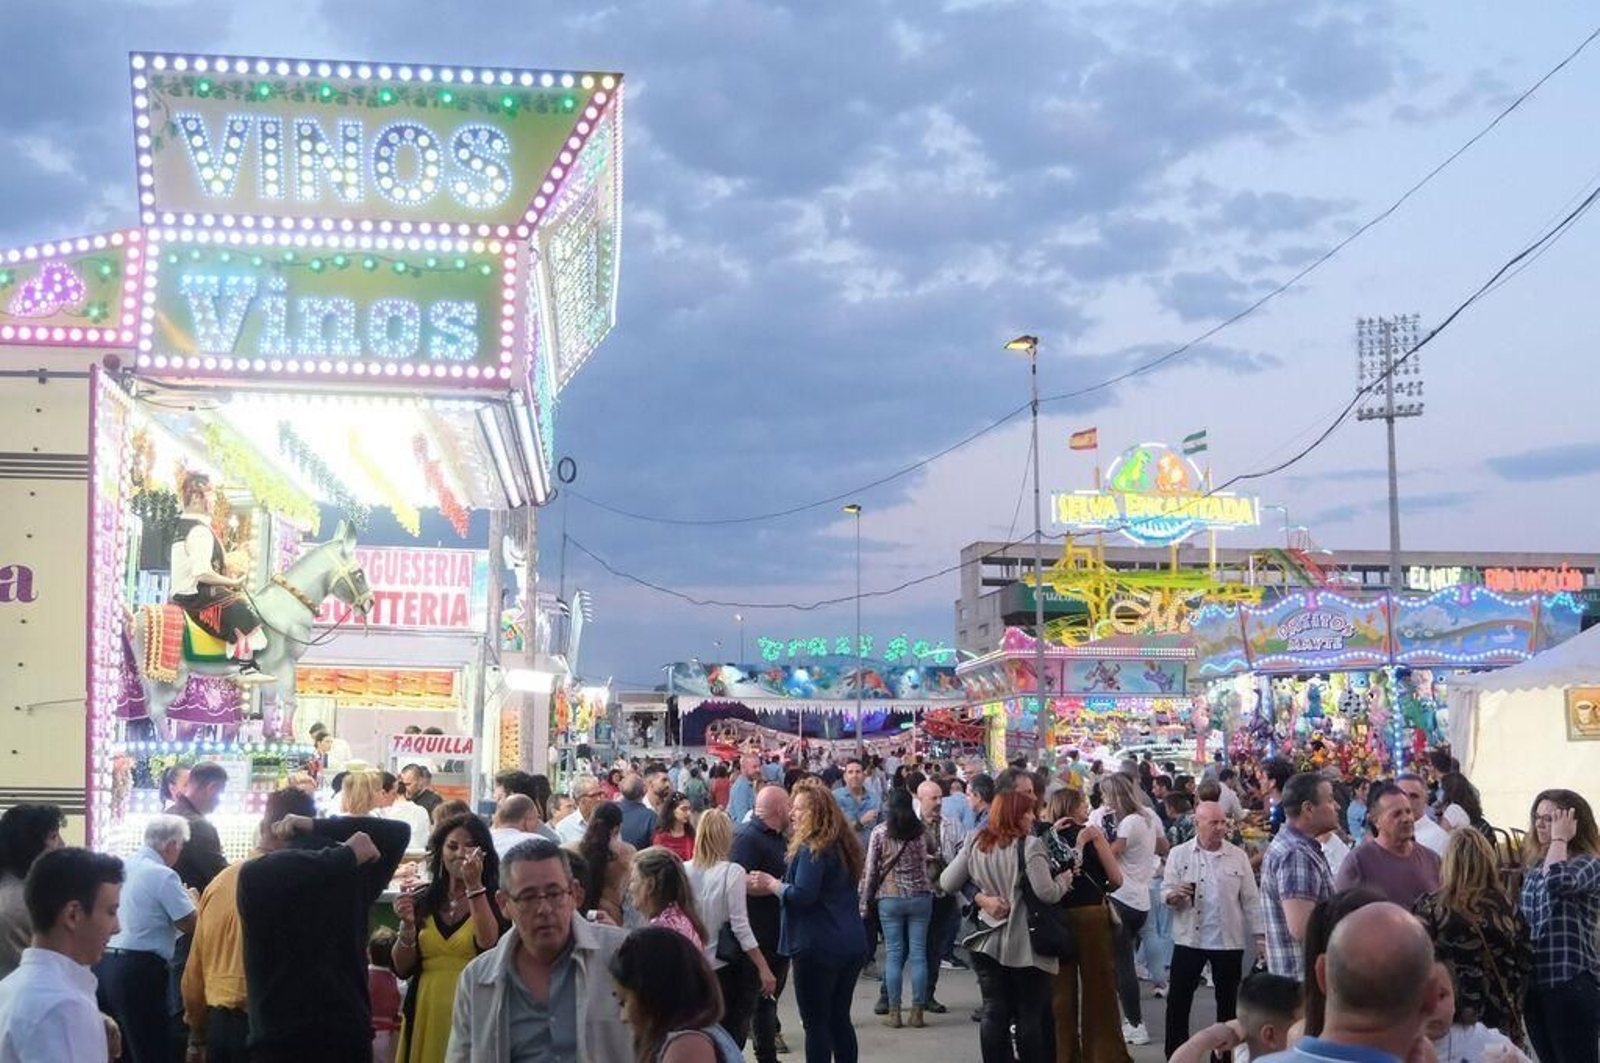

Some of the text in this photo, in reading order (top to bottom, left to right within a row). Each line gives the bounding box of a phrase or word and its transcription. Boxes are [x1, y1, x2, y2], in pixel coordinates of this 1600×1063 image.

[175, 112, 512, 209] VINOS
[178, 273, 480, 363] Vinos
[1058, 494, 1119, 524] SELVA
[1278, 612, 1357, 640] PATITOS
[393, 735, 474, 754] TAQUILLA
